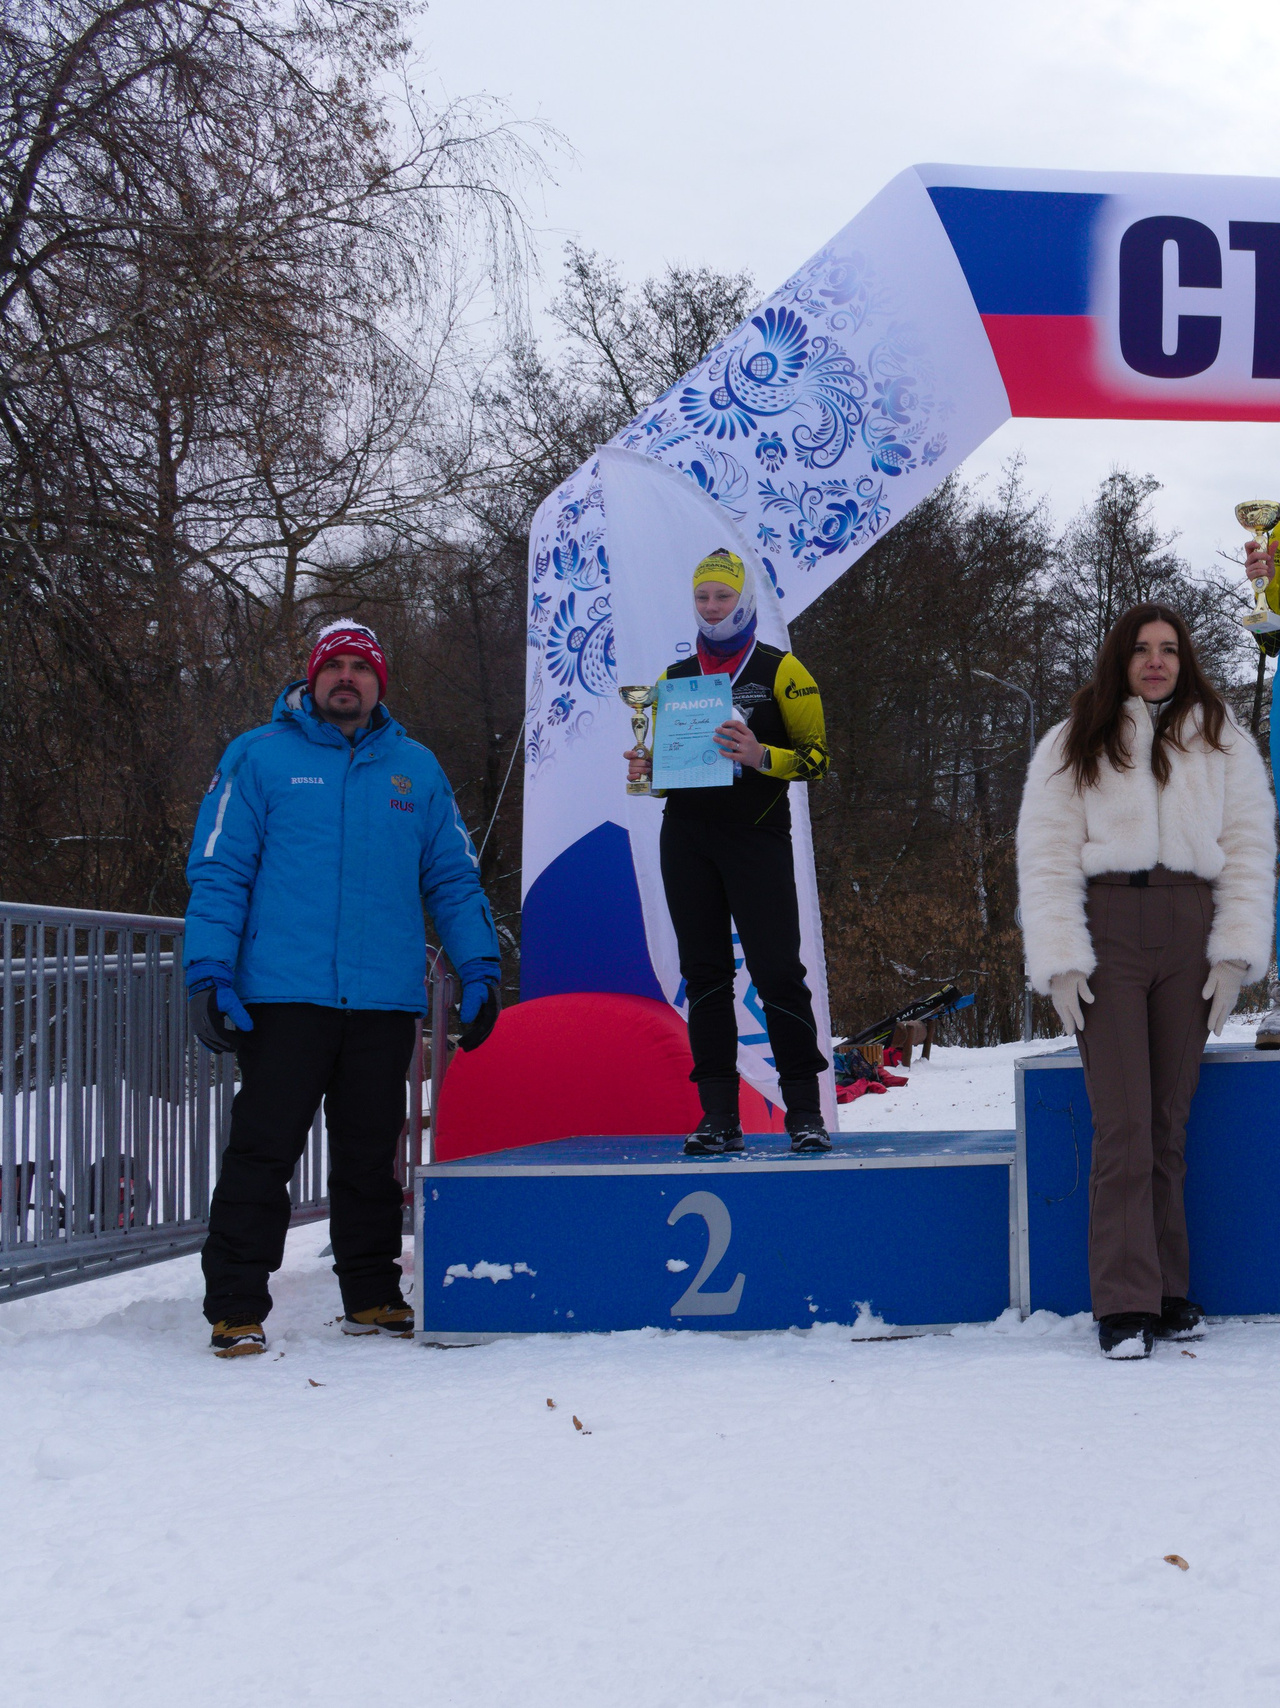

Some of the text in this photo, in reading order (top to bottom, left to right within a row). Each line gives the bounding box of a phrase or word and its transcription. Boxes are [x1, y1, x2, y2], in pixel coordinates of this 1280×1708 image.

[664, 697, 724, 712] ГРАМОТА
[290, 777, 325, 785] RUSSIA
[390, 799, 415, 813] RUS
[667, 1191, 746, 1316] 2
